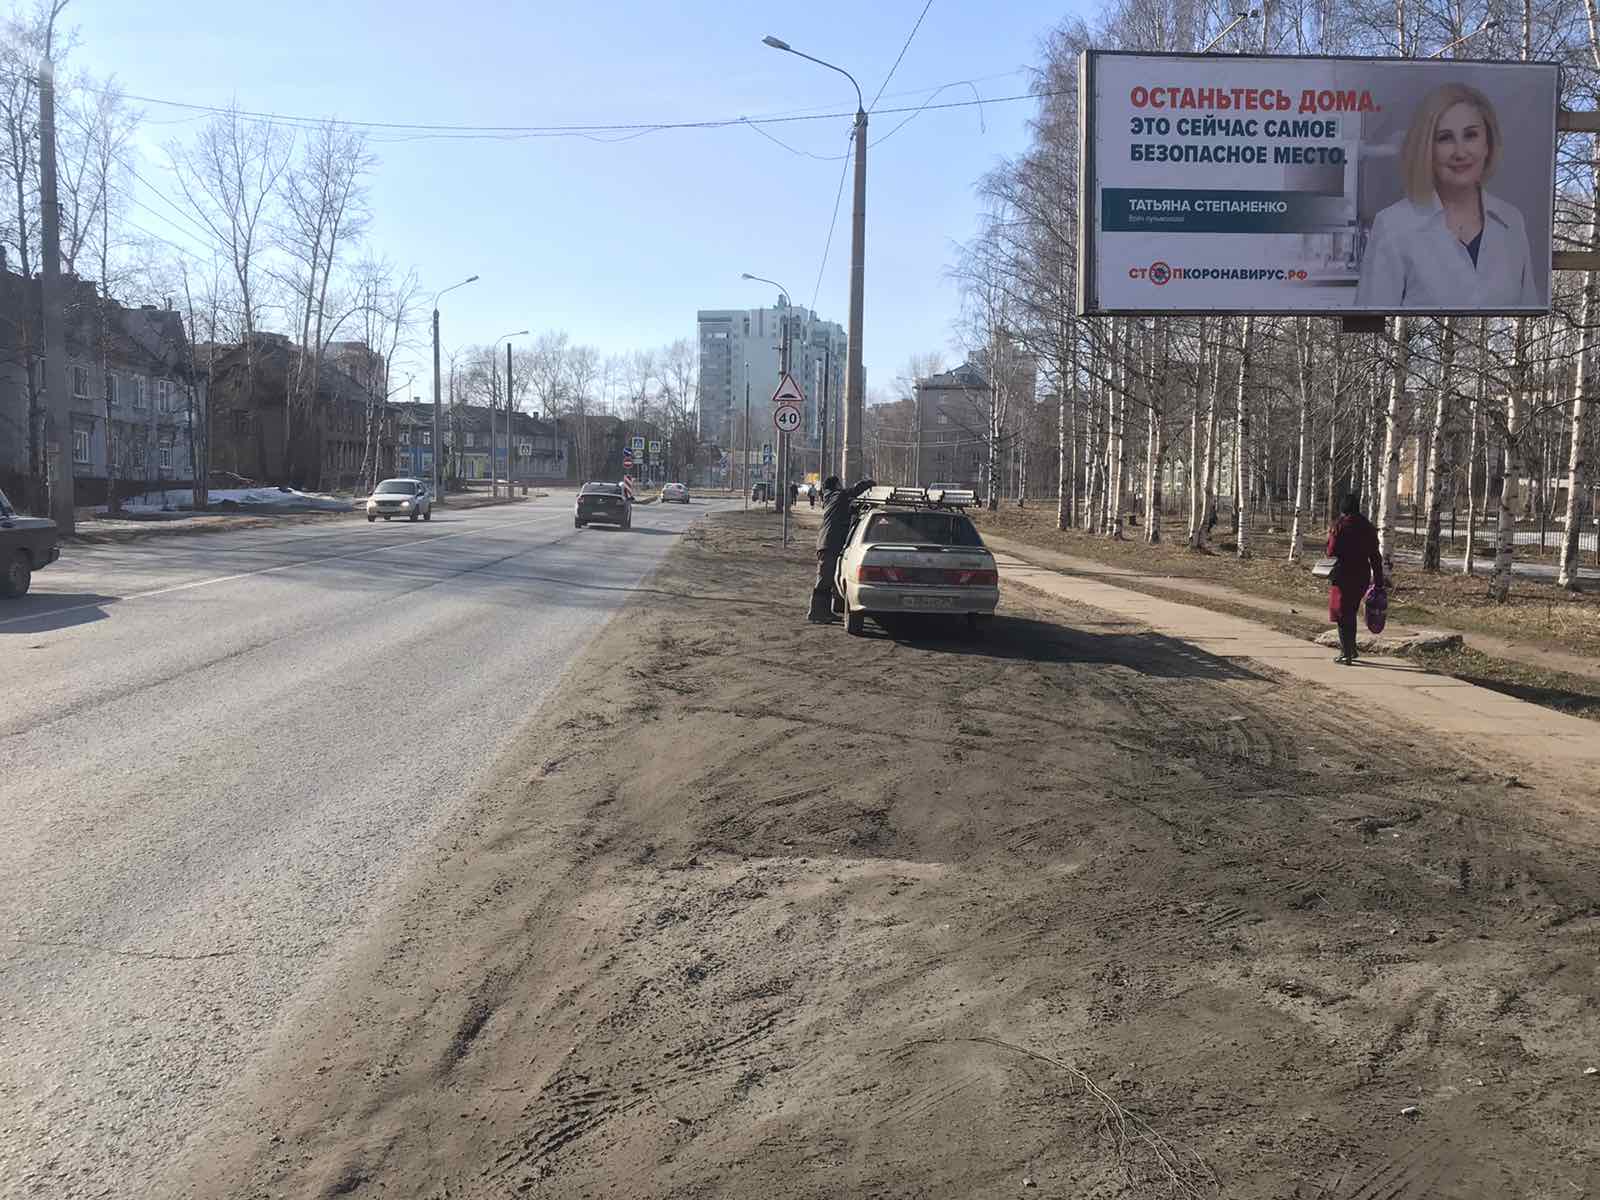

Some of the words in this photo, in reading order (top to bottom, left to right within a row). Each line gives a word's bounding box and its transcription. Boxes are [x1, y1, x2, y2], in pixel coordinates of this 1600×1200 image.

[1130, 86, 1291, 112] ОСТАНЬТЕСЬ
[1298, 90, 1382, 115] ДОМА.
[1130, 117, 1170, 136] ЭТО
[1177, 115, 1258, 138] СЕЙЧАС
[1264, 119, 1336, 138] САМОЕ
[1130, 144, 1267, 164] БЕЗОПАСНОЕ
[1274, 146, 1348, 166] МЕСТО.
[1128, 199, 1191, 212] ТАТЬЯНА
[1194, 199, 1288, 213] СТЕПАНЕНКО
[779, 412, 797, 425] 40
